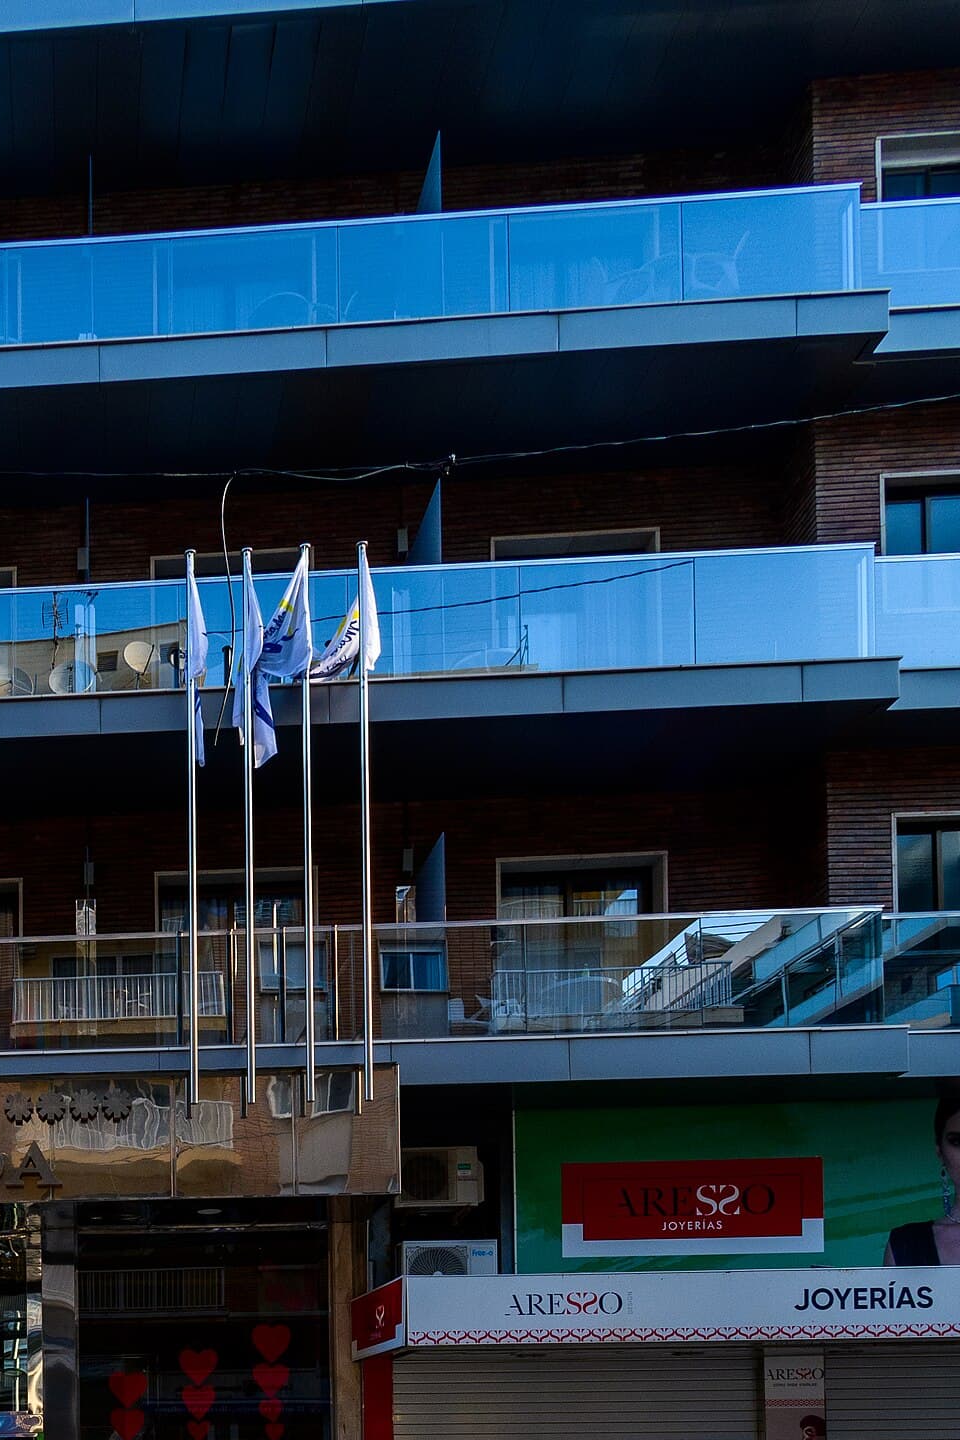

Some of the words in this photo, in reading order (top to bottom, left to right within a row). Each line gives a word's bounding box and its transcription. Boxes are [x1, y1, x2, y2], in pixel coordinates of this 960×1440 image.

[617, 1183, 776, 1217] ARESSO
[662, 1219, 723, 1231] JOYERÍAS
[504, 1291, 623, 1316] ARESSO
[794, 1281, 934, 1311] JOYERÍAS
[767, 1367, 824, 1380] ARESSO
